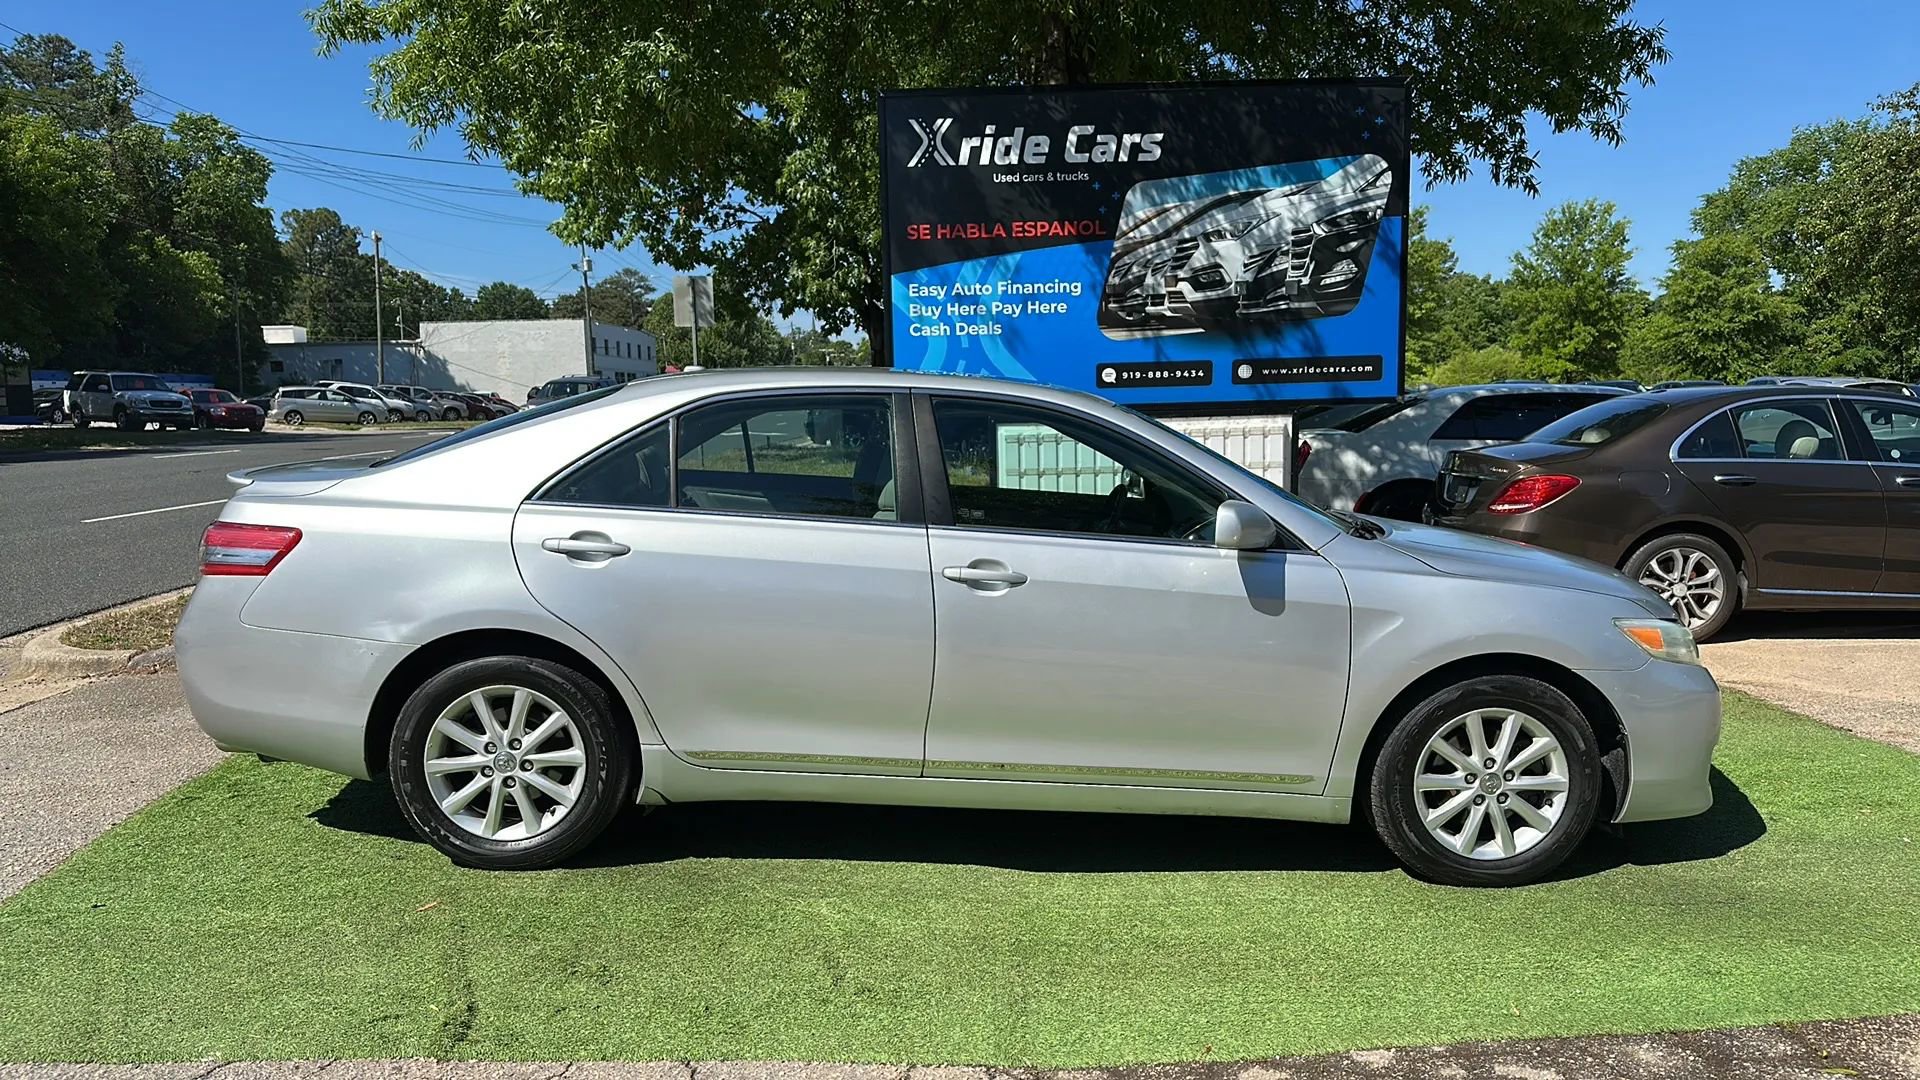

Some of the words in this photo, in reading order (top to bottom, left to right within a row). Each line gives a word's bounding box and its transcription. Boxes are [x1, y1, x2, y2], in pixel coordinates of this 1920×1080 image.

[907, 118, 1050, 167] Xride
[1064, 125, 1164, 164] Cars
[993, 173, 1020, 183] Used
[1022, 174, 1044, 182] cars
[1047, 172, 1054, 182] &
[1056, 171, 1089, 182] trucks
[907, 224, 931, 240] SE
[937, 222, 1006, 240] HABLA
[1012, 220, 1106, 238] ESPANOL
[908, 283, 947, 299] Easy
[952, 282, 992, 296] Auto
[998, 279, 1082, 296] Financing
[909, 303, 943, 319] Buy
[947, 302, 987, 316] Here
[992, 301, 1023, 317] Pay
[1027, 300, 1068, 314] Here
[909, 323, 950, 336] Cash
[956, 321, 1002, 336] Deals
[1122, 369, 1204, 379] 919-888-9434
[1262, 365, 1373, 375] www.xridecars.com
